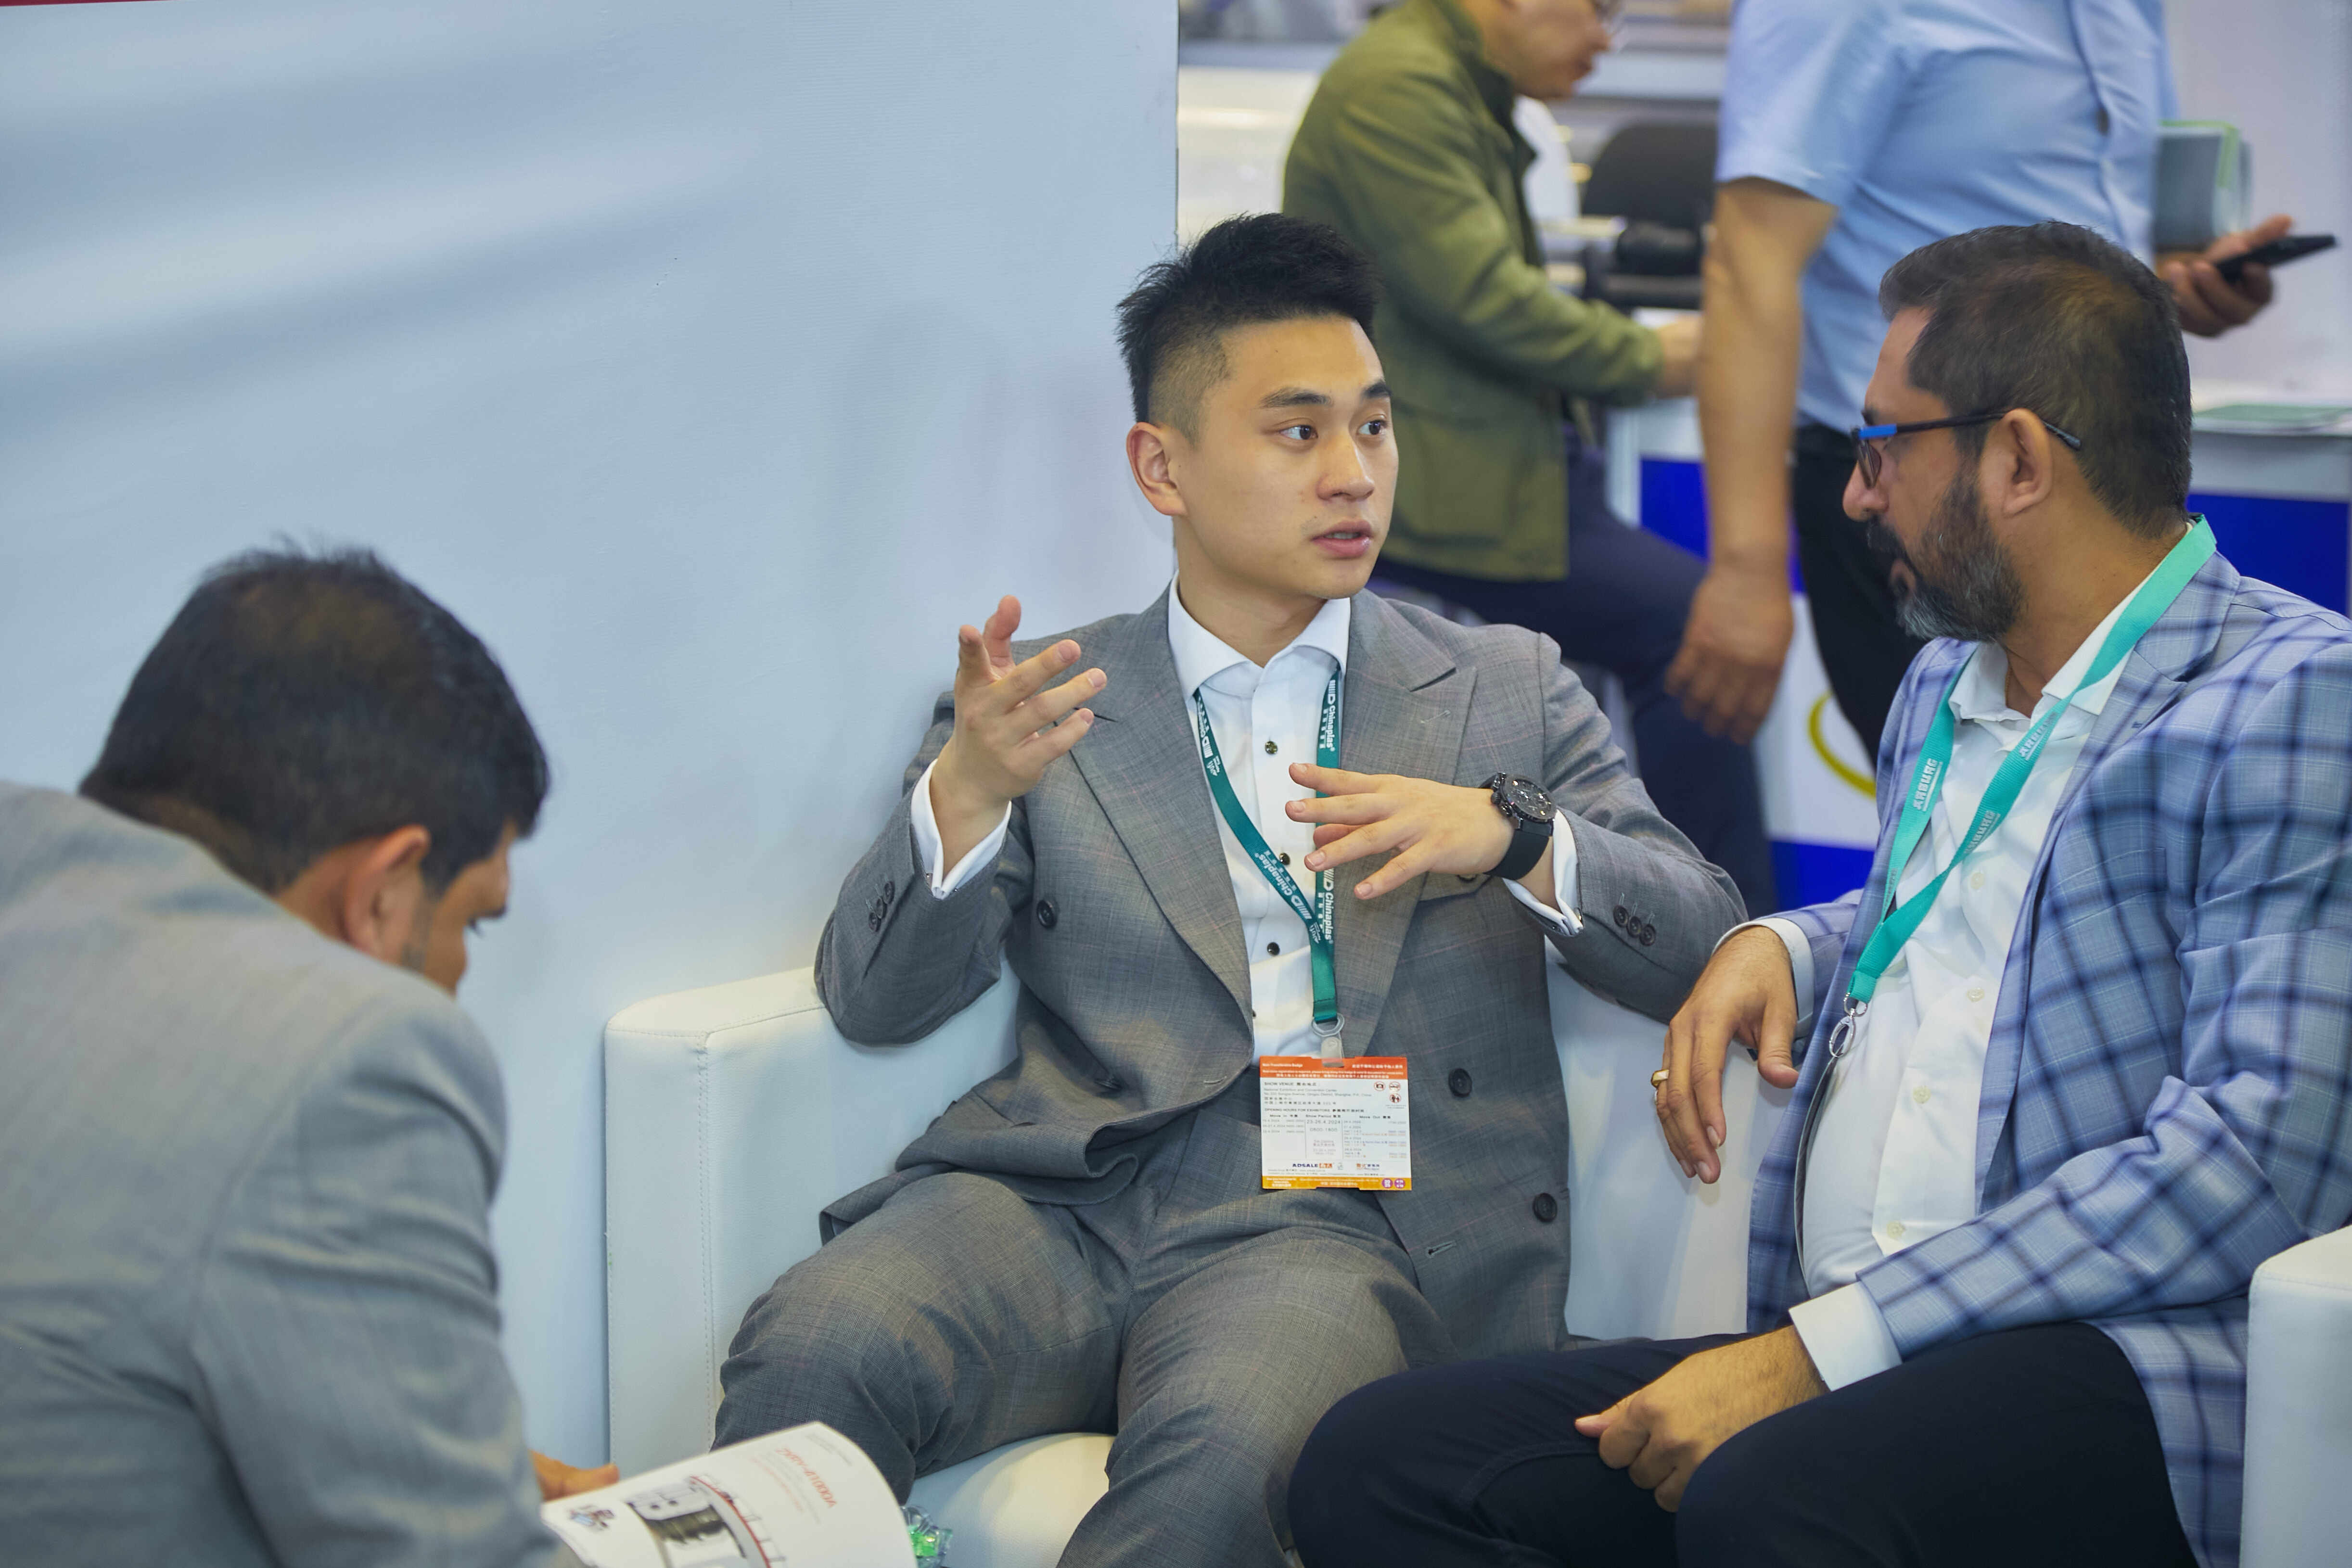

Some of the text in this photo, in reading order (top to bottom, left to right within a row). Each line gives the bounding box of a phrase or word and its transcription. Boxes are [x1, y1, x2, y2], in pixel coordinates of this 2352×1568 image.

[1913, 758, 1938, 810] ARBURG
[1259, 854, 1293, 895] Chinaplas
[1323, 892, 1334, 940] Chinaplas
